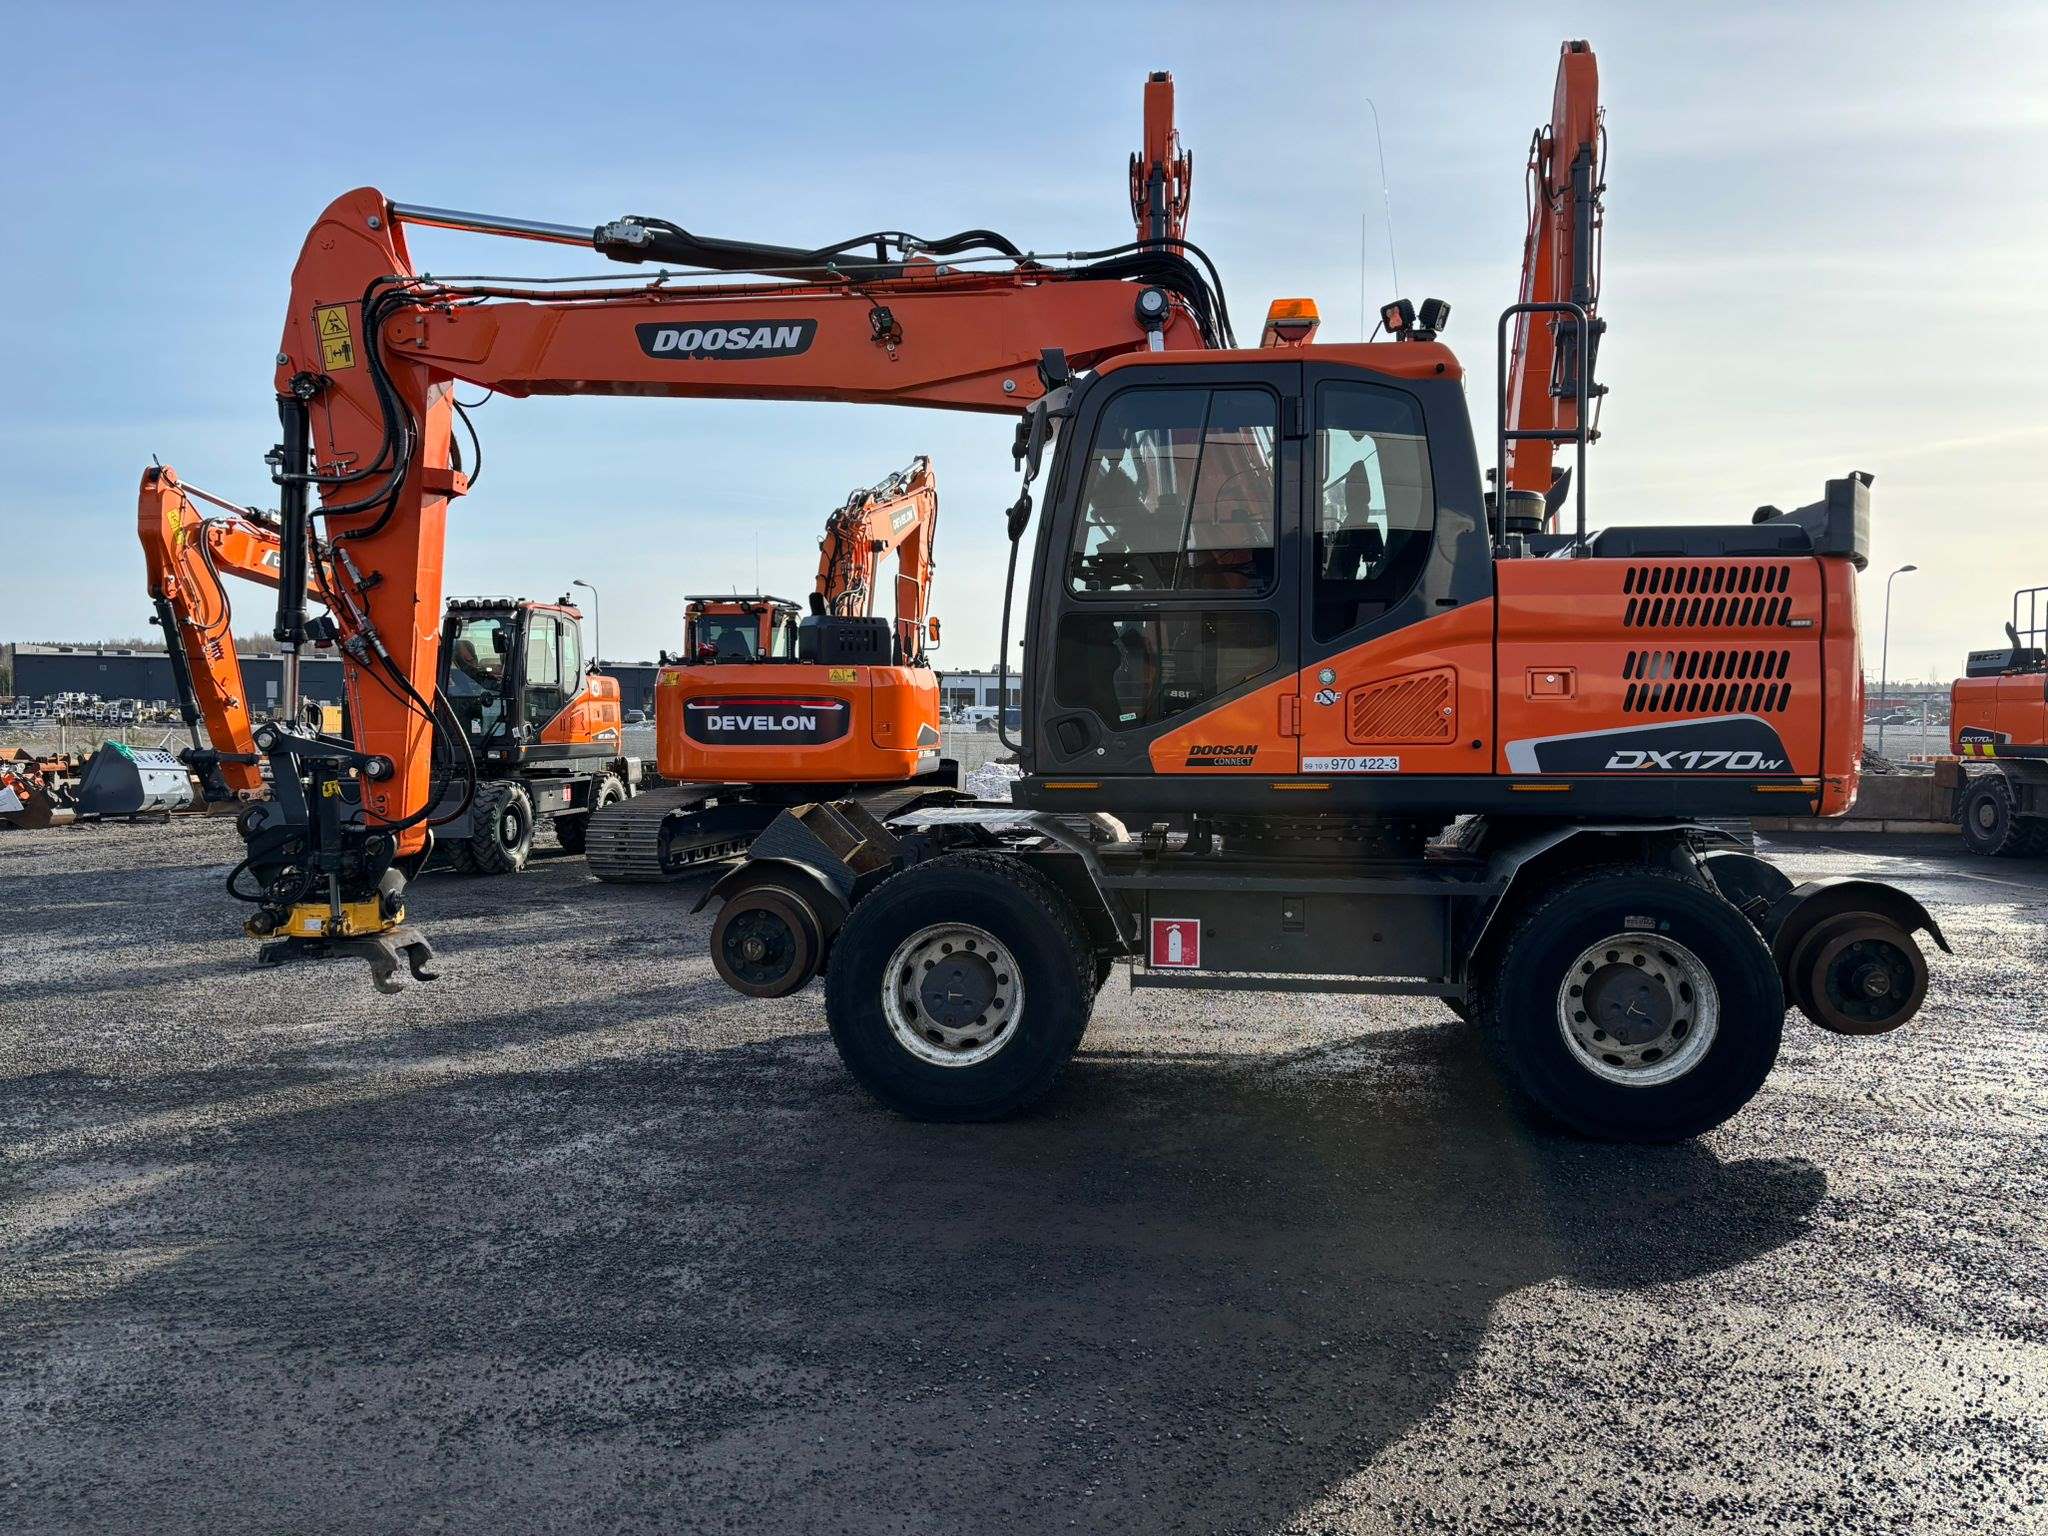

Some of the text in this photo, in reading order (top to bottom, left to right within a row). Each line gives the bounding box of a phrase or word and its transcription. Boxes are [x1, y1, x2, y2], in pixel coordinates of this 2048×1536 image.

[653, 326, 802, 352] DOOSAN
[707, 715, 816, 731] DEVELON
[1189, 744, 1259, 756] DOOSAN
[1213, 757, 1252, 766] CONNECT
[1331, 758, 1356, 770] 970
[1360, 758, 1398, 770] 422-3
